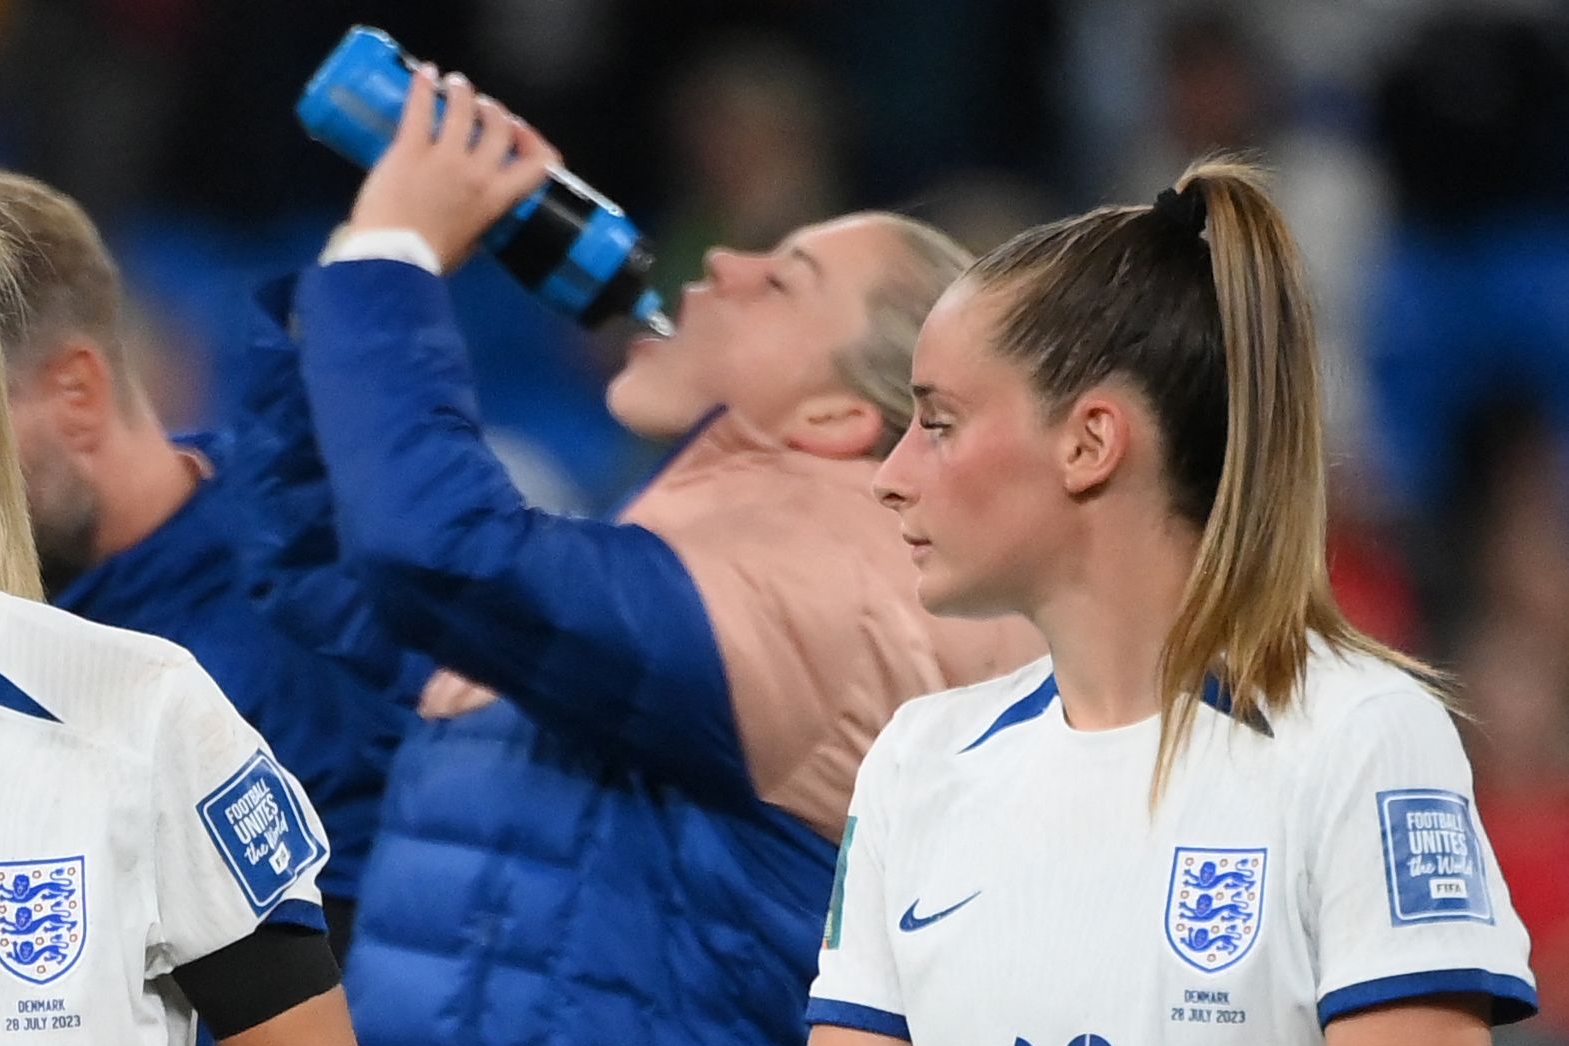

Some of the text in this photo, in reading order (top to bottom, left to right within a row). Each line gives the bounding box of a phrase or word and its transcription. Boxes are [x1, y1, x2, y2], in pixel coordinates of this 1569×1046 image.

[224, 777, 271, 824] FOOTBALL
[233, 793, 279, 845] UNITES
[1406, 812, 1465, 832] FOOTBALL
[1408, 829, 1469, 857] UNITES
[244, 842, 269, 866] the
[1407, 855, 1437, 878] the
[1436, 883, 1462, 894] FIFA
[17, 999, 66, 1014] DENMARK
[1184, 989, 1230, 1005] DENMARK
[6, 1014, 81, 1032] 28 JULY 2023
[1171, 1007, 1246, 1024] 28 JULY 2023
